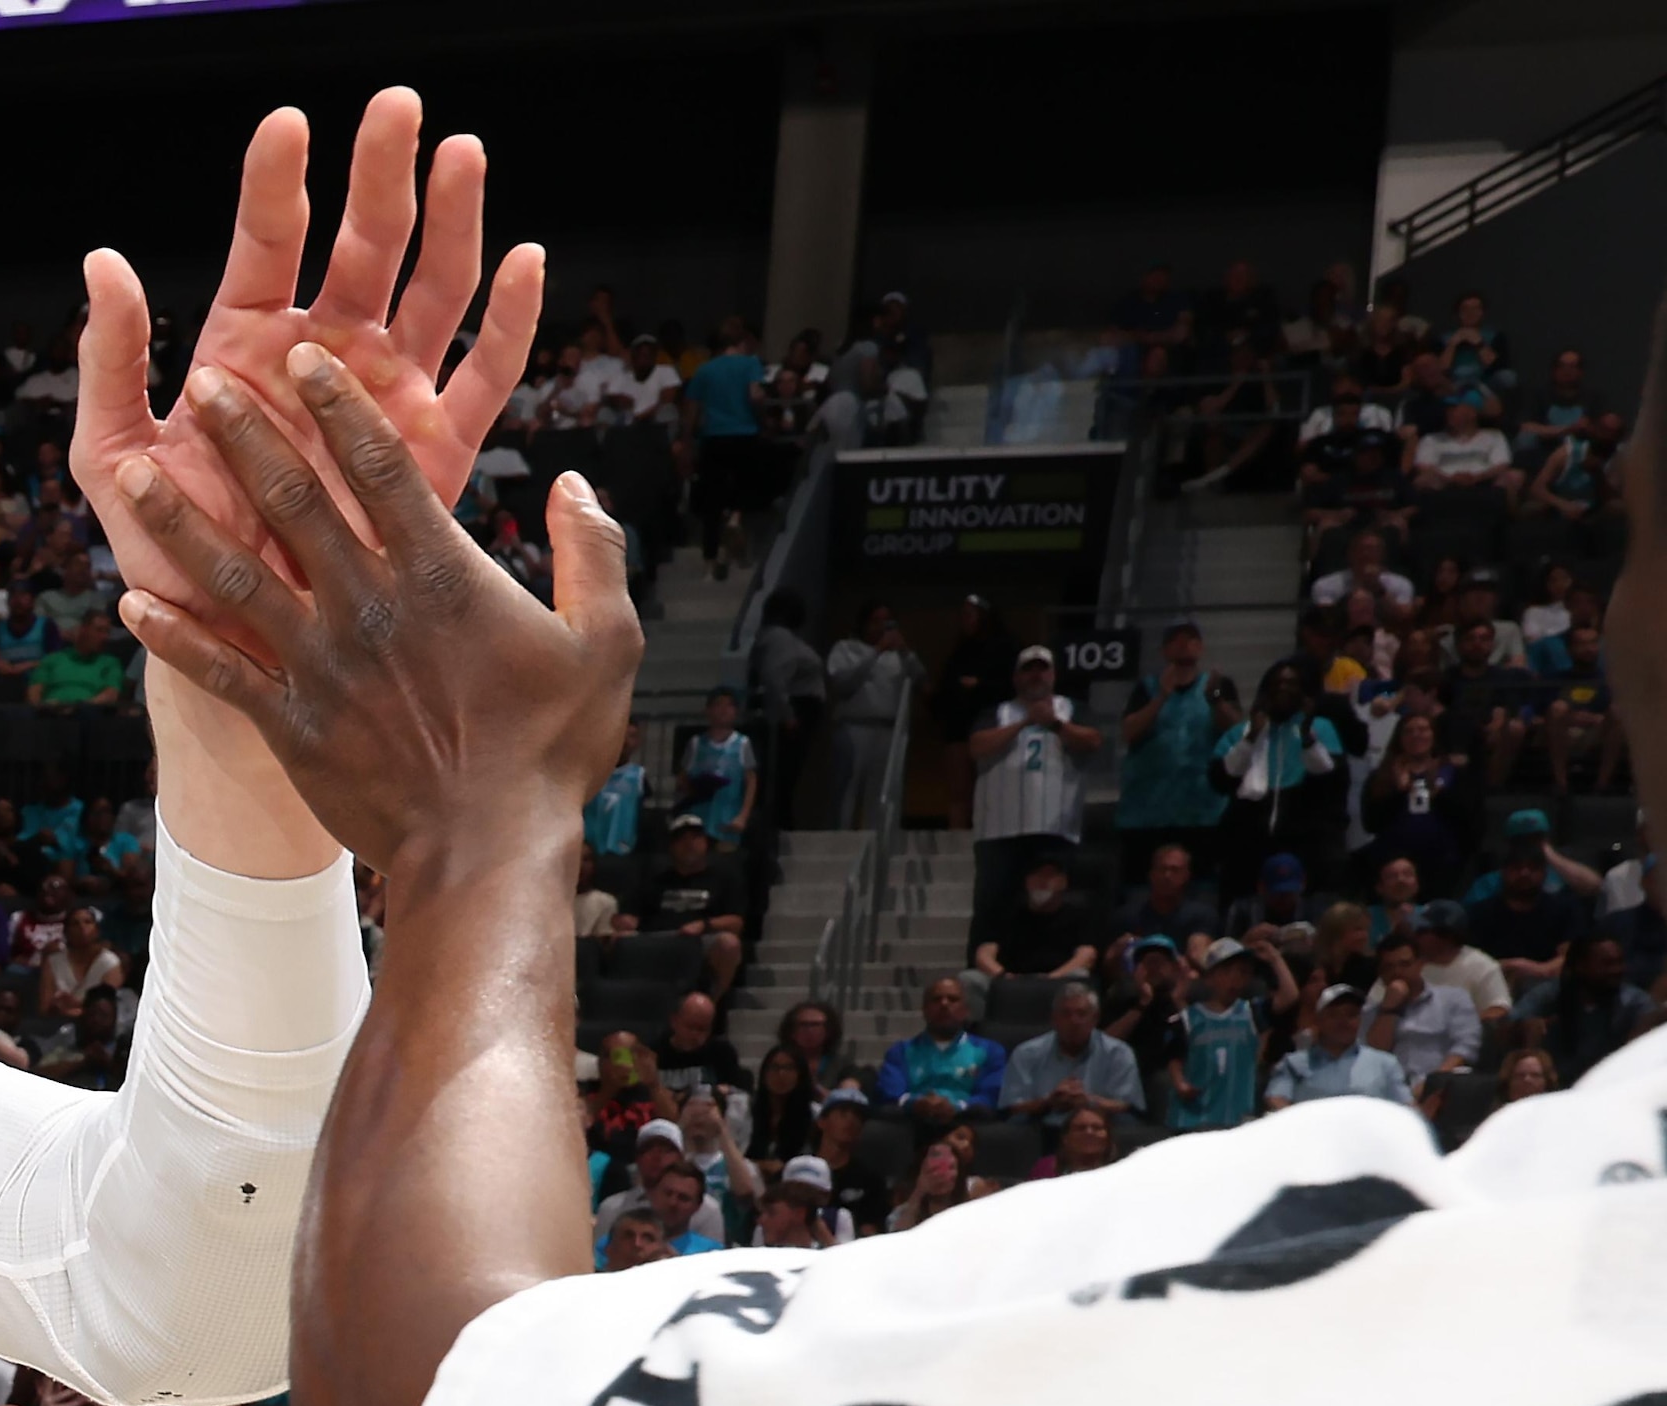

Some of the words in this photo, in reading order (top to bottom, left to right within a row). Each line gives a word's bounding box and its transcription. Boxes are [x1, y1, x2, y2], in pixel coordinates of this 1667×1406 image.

[867, 473, 1005, 504] UTILITY
[907, 502, 1086, 529] INNOVATION
[862, 532, 956, 556] GROUP
[1064, 641, 1126, 671] 103
[1025, 739, 1042, 771] 2
